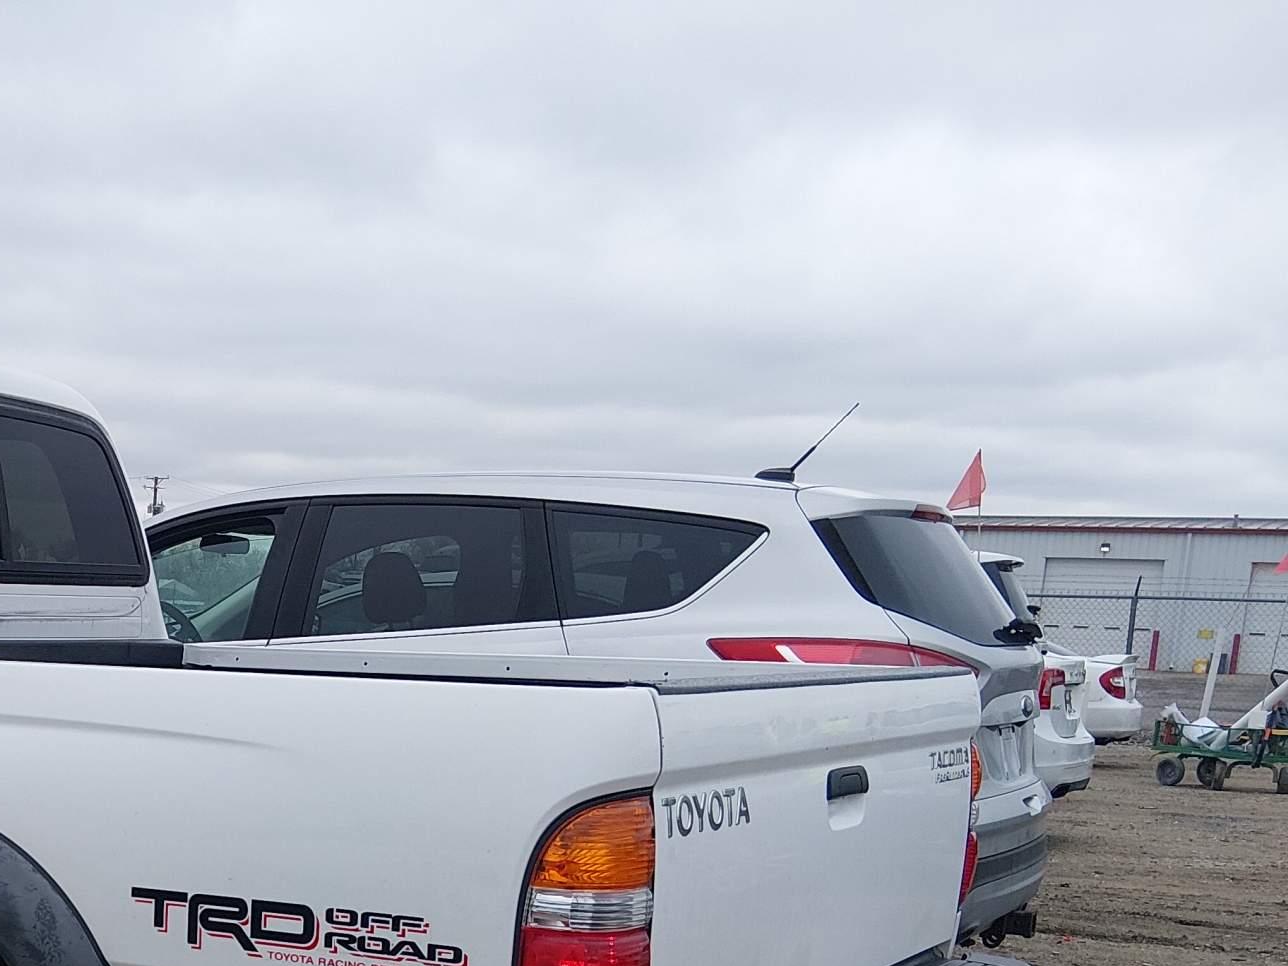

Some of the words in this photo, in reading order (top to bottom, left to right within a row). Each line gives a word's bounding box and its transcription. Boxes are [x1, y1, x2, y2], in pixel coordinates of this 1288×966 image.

[929, 746, 969, 770] TACOMA
[661, 786, 750, 838] TOYOTA
[131, 886, 320, 958] TRD
[325, 907, 429, 937] OFF
[267, 951, 314, 965] TOYOTA
